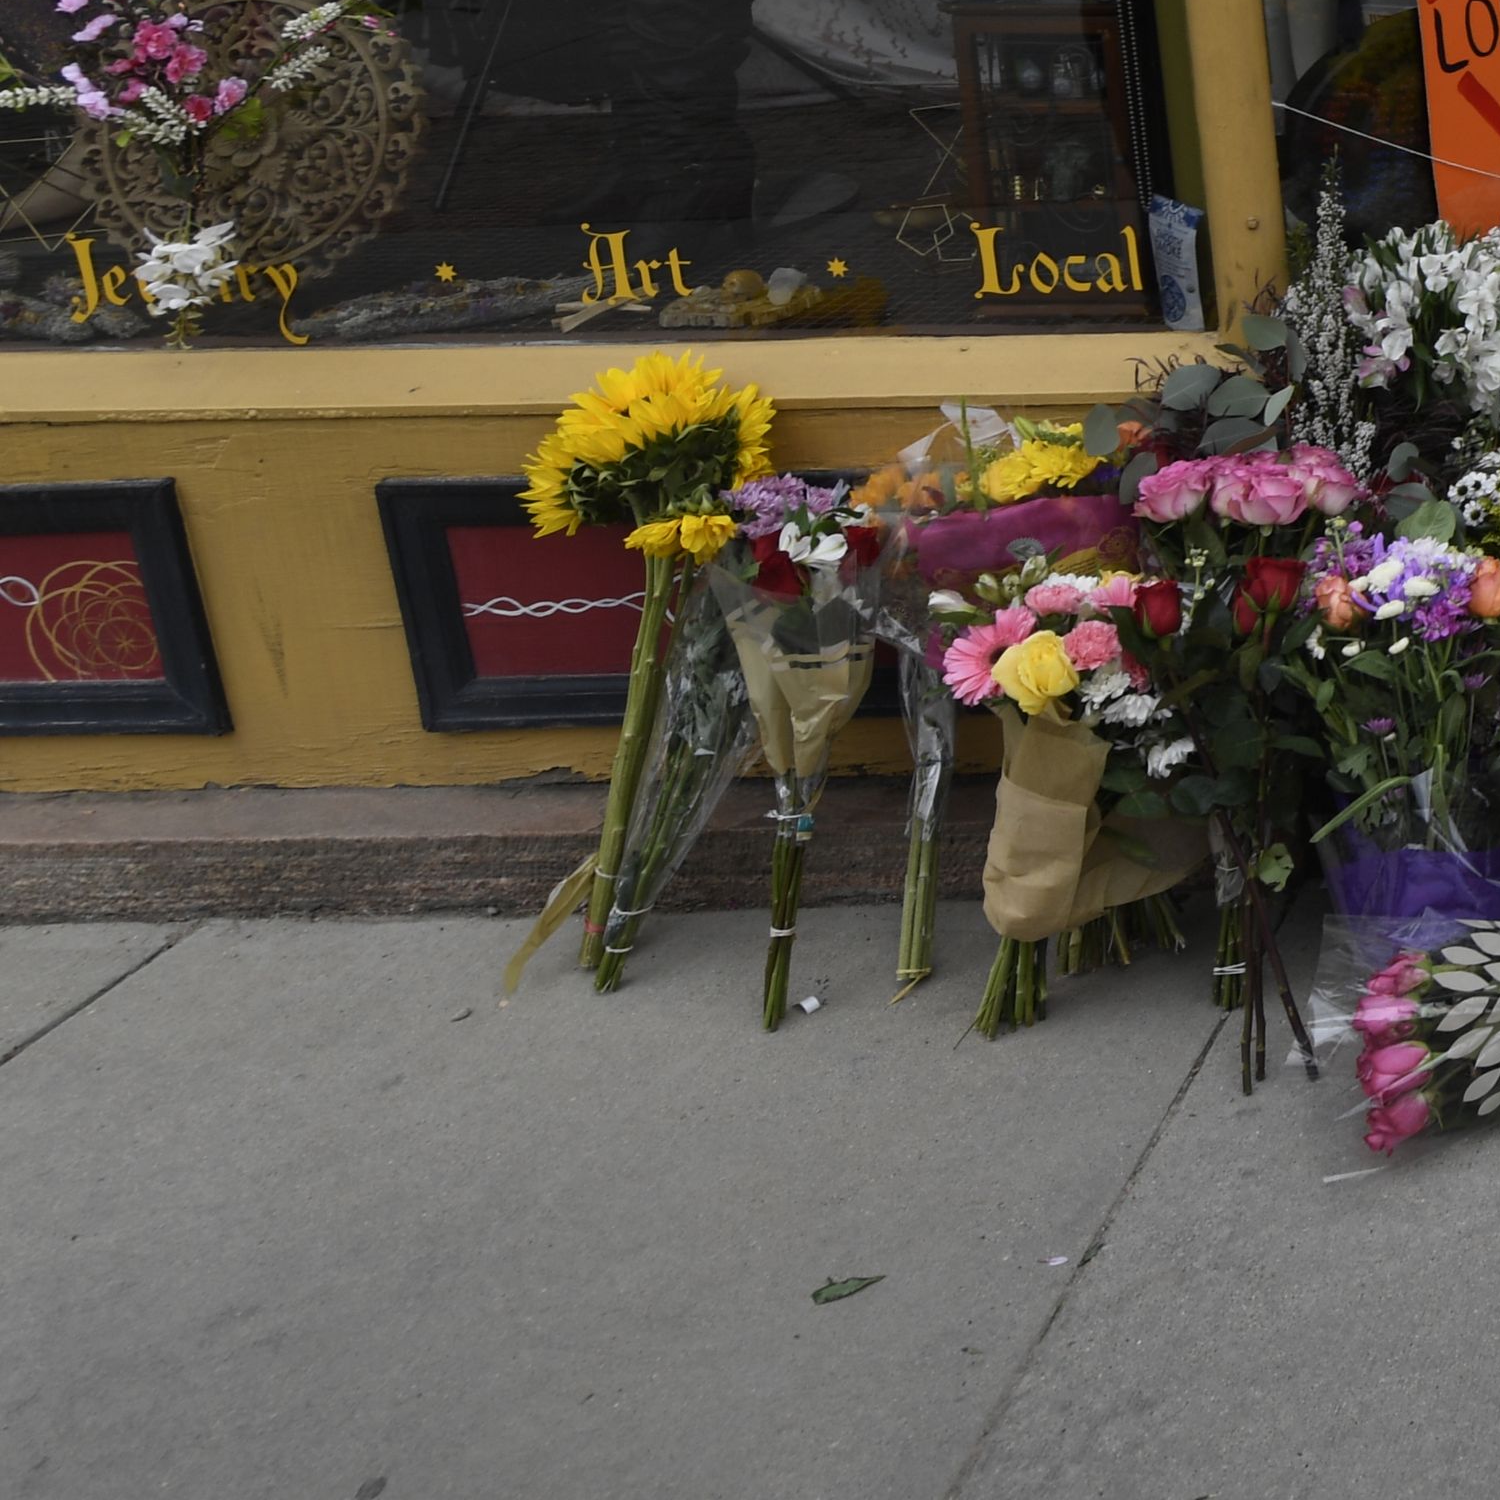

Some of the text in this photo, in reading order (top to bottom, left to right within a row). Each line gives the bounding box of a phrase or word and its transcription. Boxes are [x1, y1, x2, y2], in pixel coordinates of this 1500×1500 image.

[64, 231, 311, 346] Jery
[580, 220, 694, 306] Art
[972, 222, 1144, 296] Local
